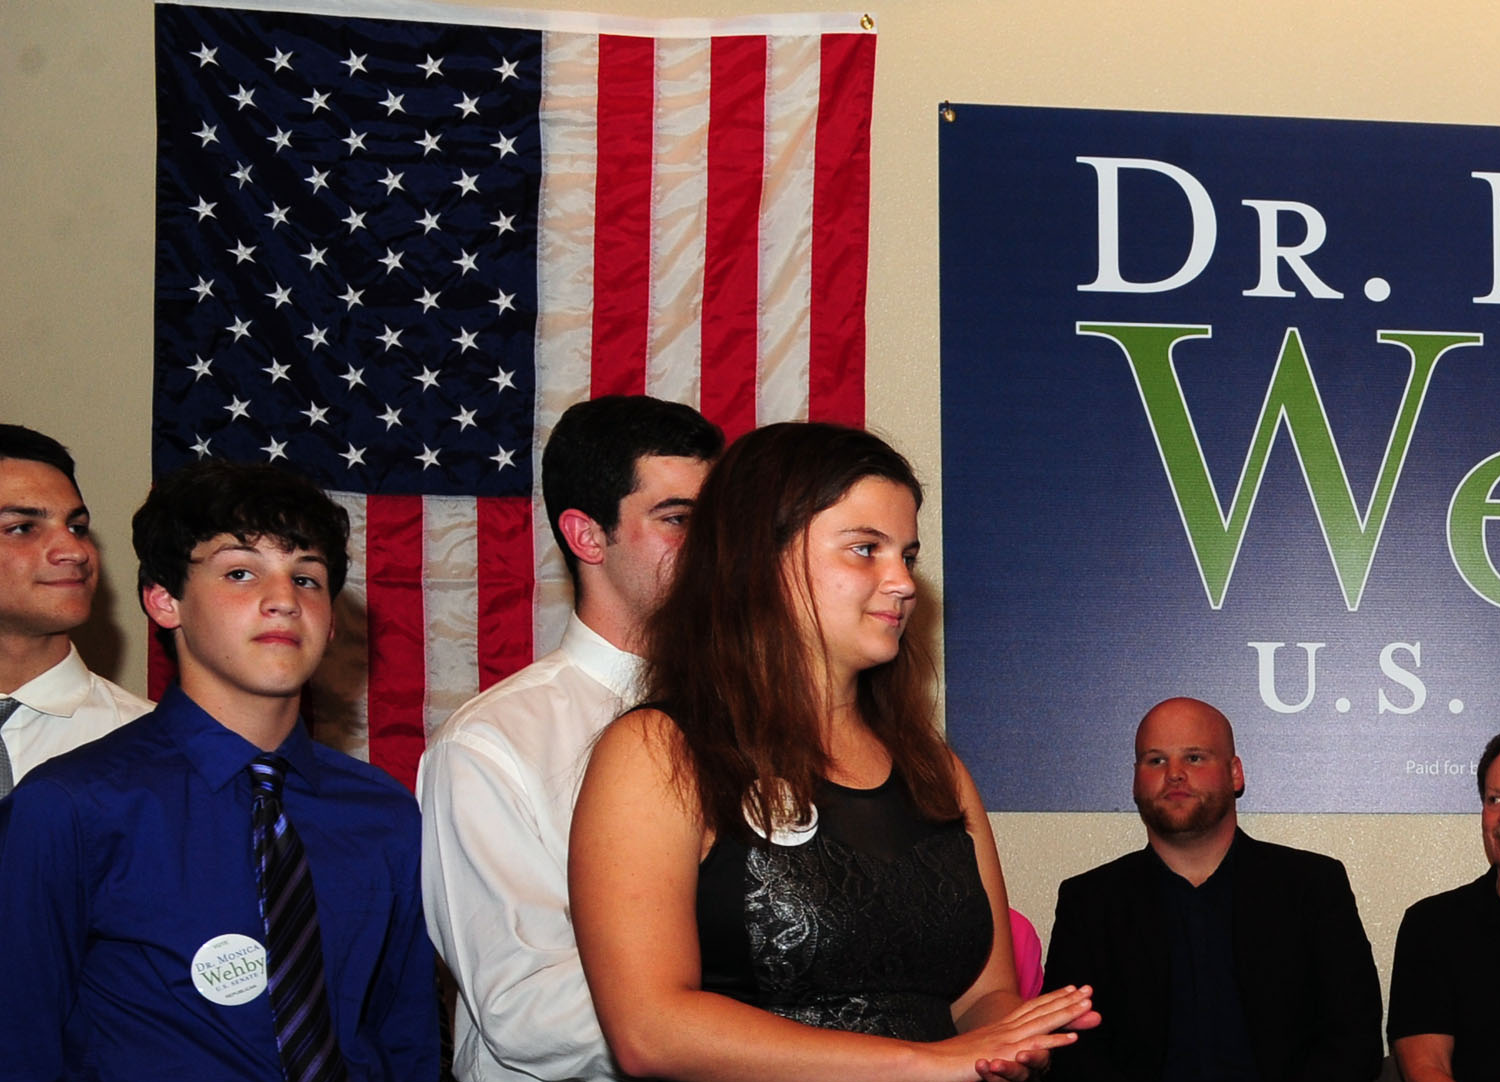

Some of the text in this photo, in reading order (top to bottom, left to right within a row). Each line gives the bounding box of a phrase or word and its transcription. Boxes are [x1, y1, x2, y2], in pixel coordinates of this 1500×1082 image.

[1075, 156, 1392, 302] DR.
[1246, 640, 1465, 715] U.S.
[1406, 759, 1439, 776] Paid
[1443, 759, 1465, 776] for
[200, 956, 265, 986] Wehby
